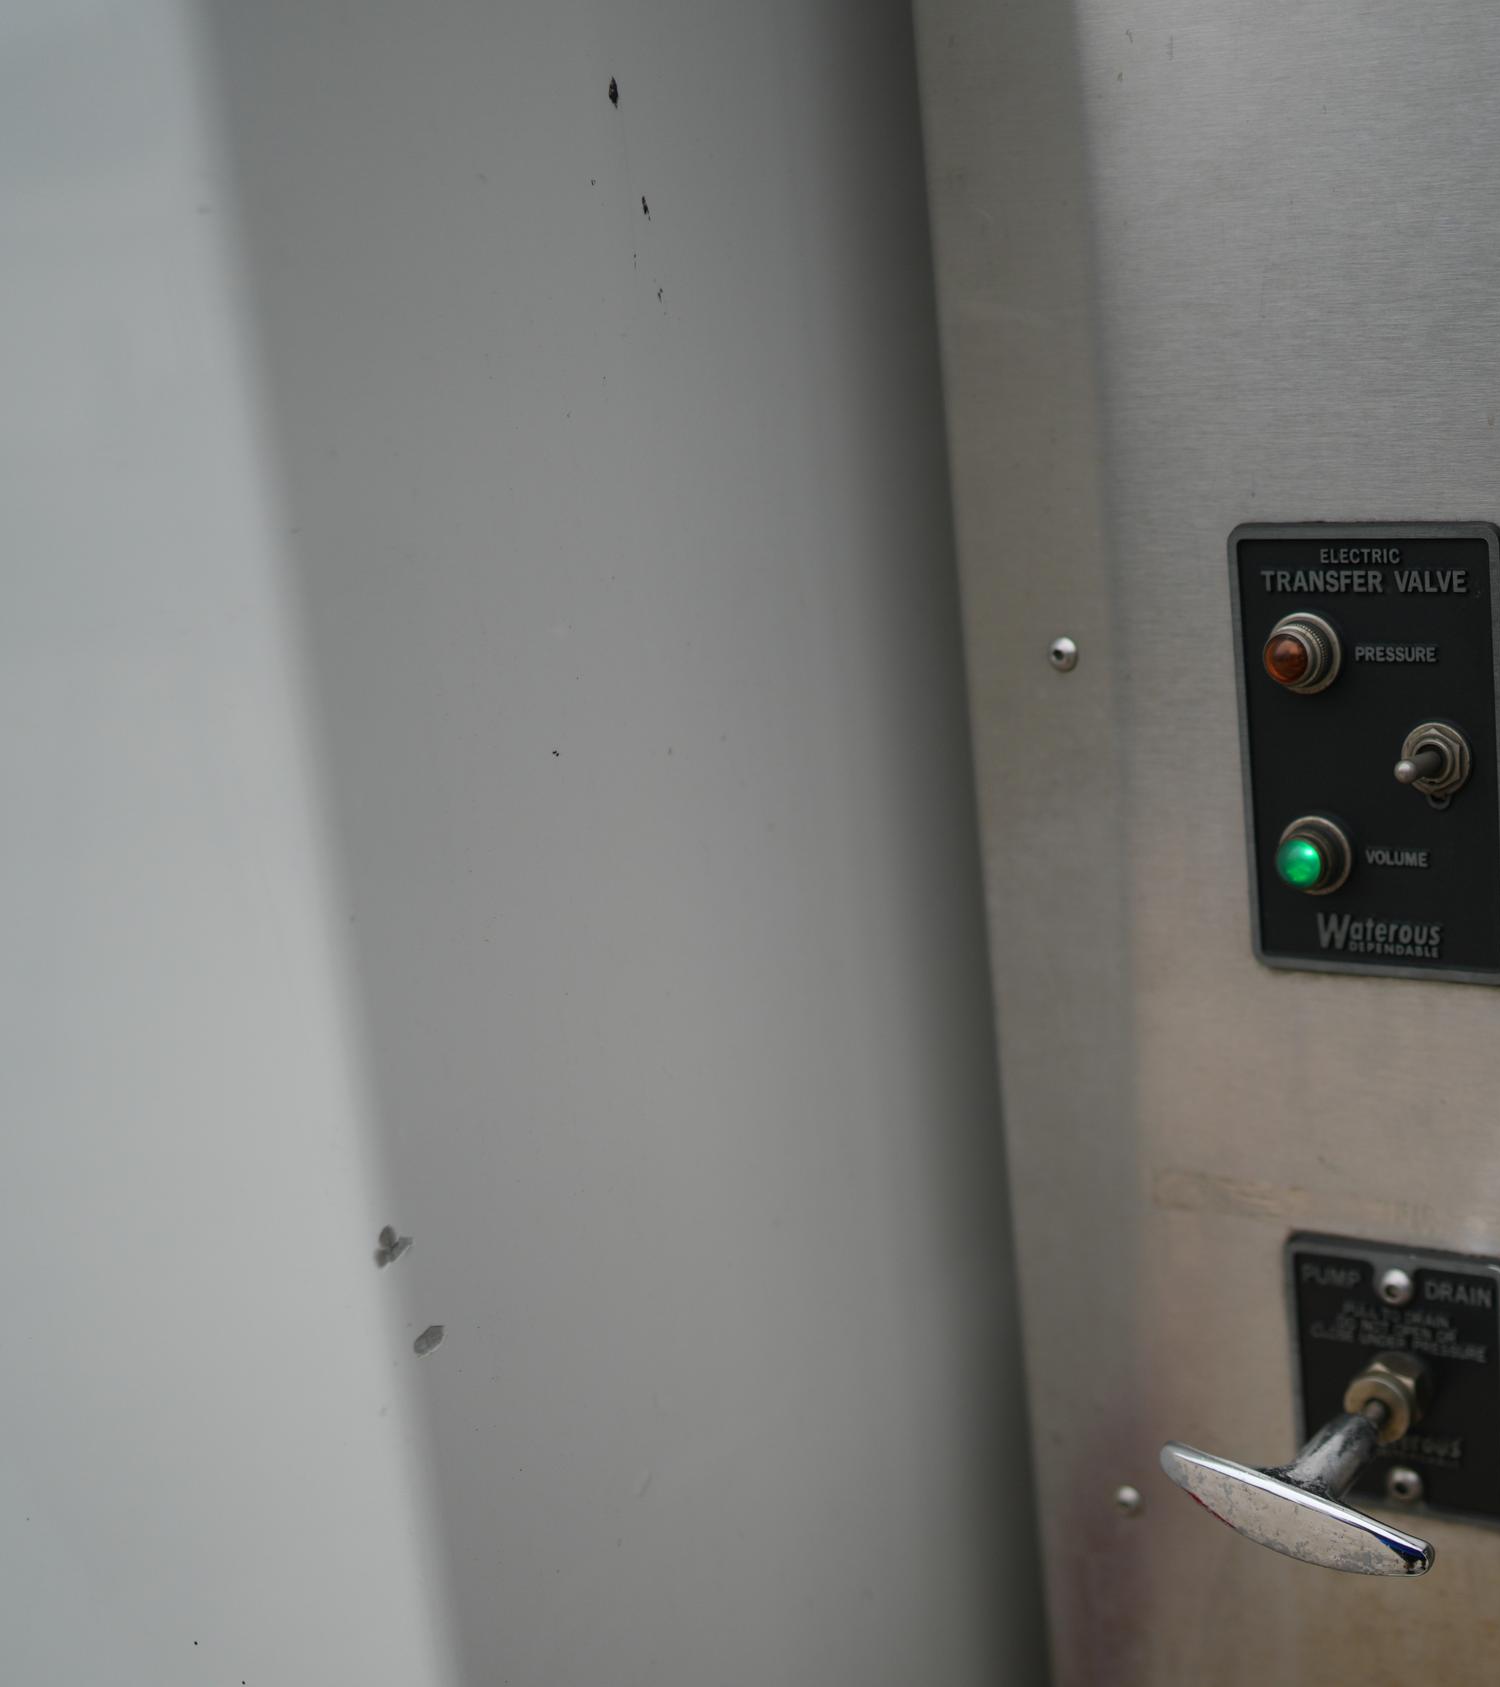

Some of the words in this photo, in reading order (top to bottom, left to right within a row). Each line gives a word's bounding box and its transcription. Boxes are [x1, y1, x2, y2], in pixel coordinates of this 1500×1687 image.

[1320, 548, 1401, 565] ELECTRIC
[1261, 570, 1383, 593] TRANSFER
[1394, 570, 1468, 594] VALVE
[1355, 646, 1437, 663] PRESSURE
[1366, 850, 1428, 867] VOLUME
[1317, 912, 1441, 950] Waterous
[1349, 942, 1439, 958] DEPENDABLE
[1302, 1263, 1361, 1287] PUMP
[1425, 1280, 1492, 1307] DRAIN
[1411, 1339, 1487, 1363] PRESSURE
